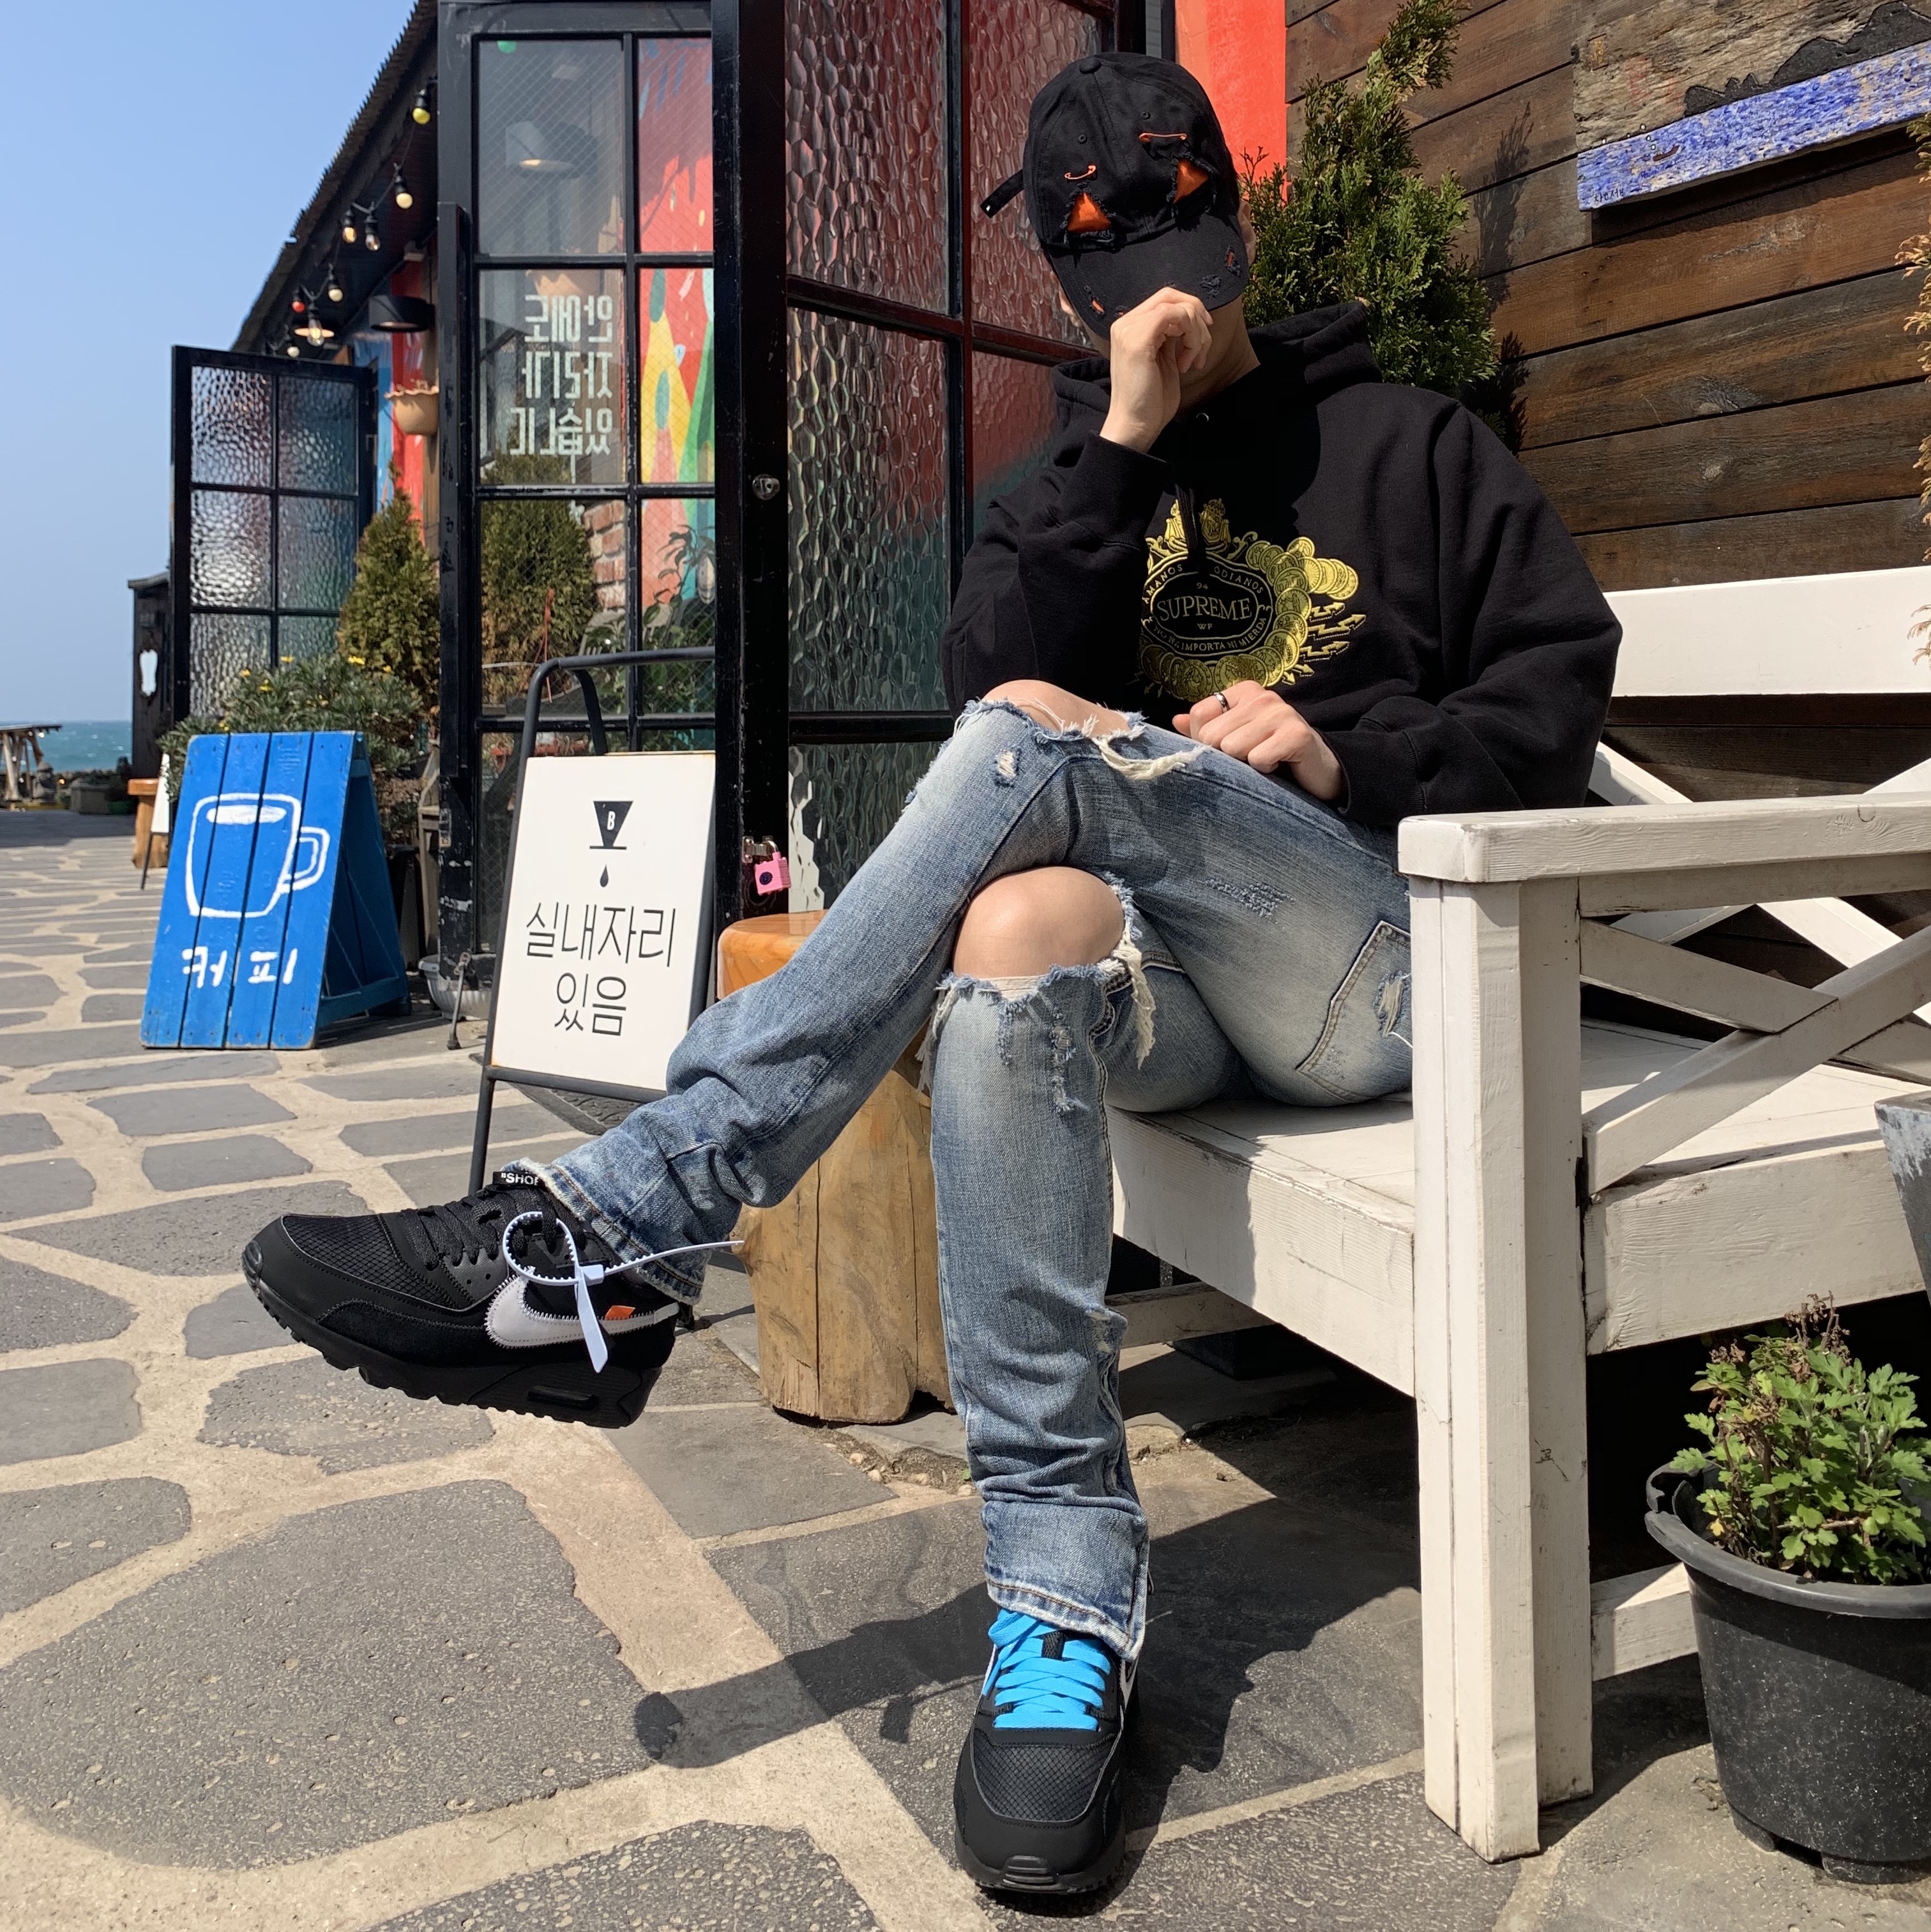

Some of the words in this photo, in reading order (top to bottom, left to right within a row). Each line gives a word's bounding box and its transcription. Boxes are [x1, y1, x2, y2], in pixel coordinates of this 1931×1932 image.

[1195, 582, 1209, 590] 94
[1156, 595, 1252, 622] SUPREME
[1181, 641, 1226, 651] IMPORTA
[1227, 640, 1238, 648] NI
[1238, 618, 1267, 646] MIERDA
[607, 810, 616, 831] B
[526, 901, 677, 968] 실내자리
[181, 945, 298, 989] 커피
[554, 972, 627, 1037] 있음
